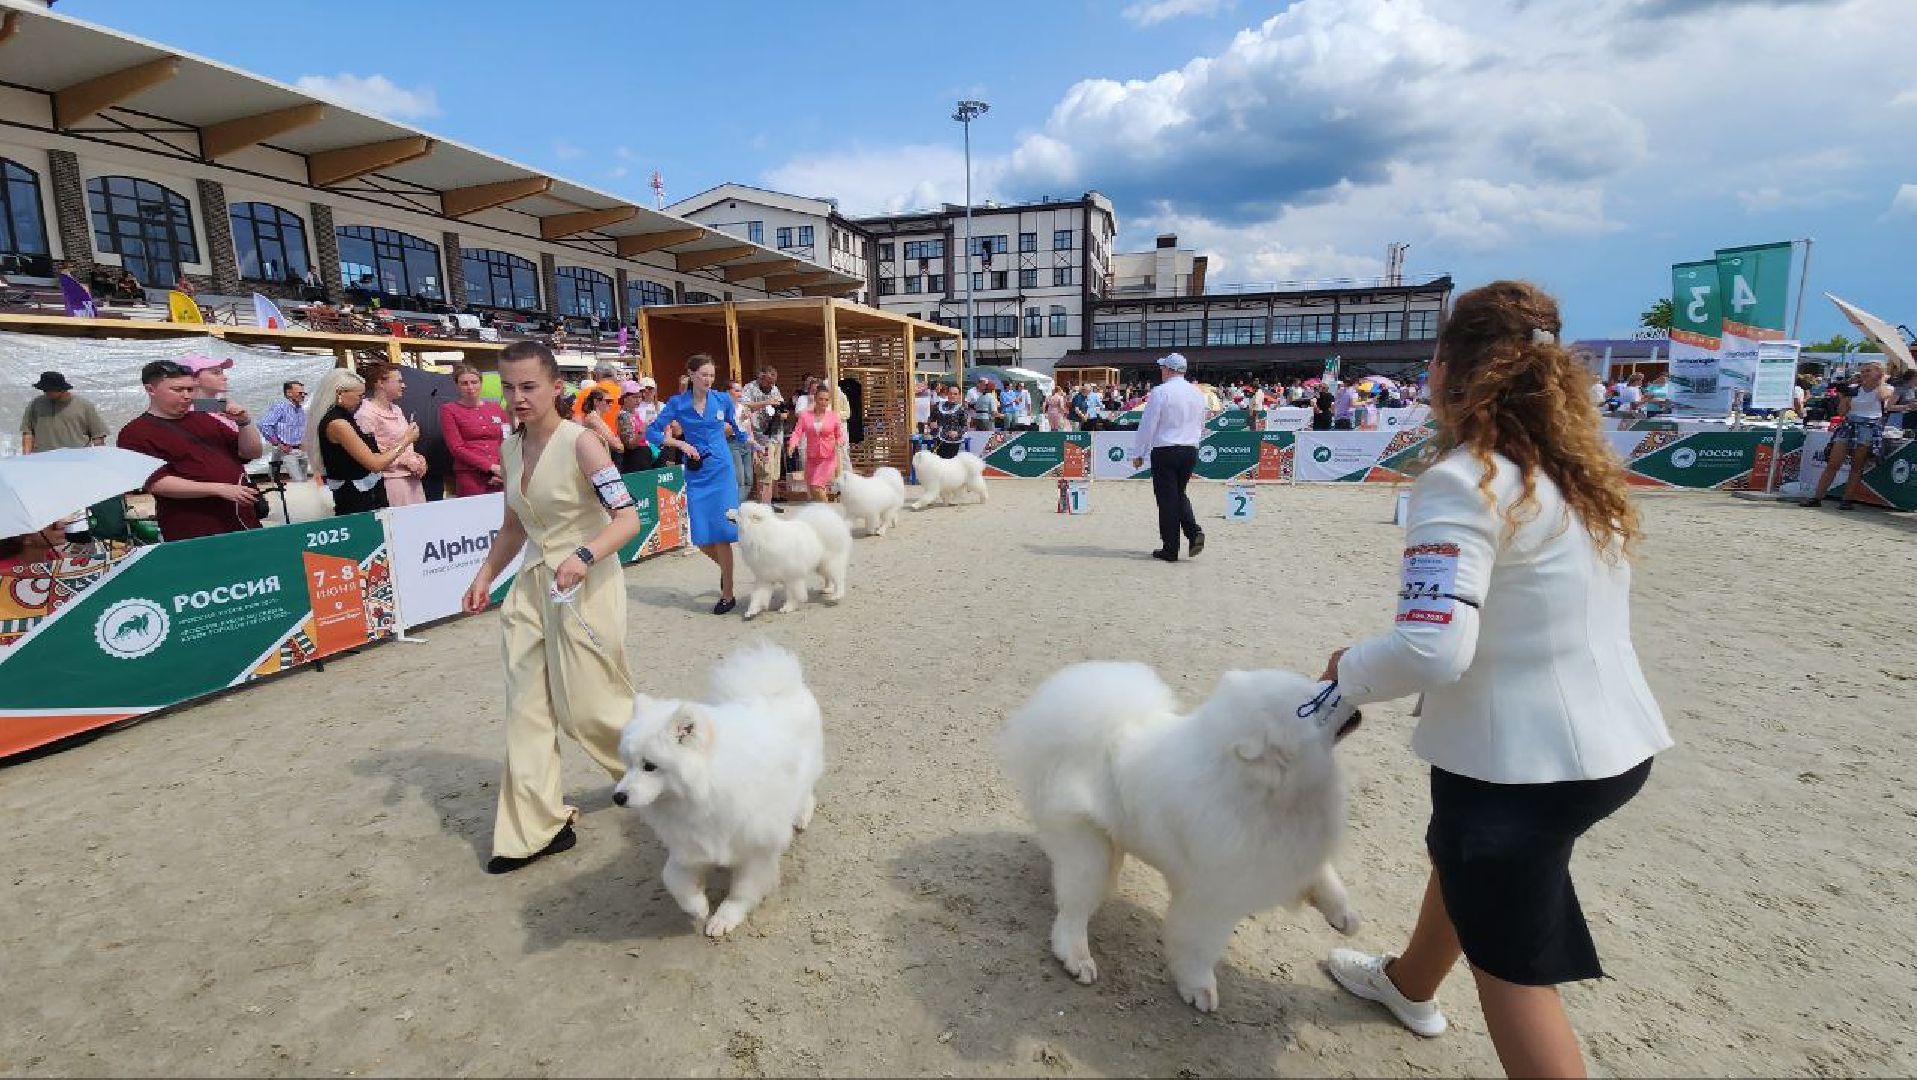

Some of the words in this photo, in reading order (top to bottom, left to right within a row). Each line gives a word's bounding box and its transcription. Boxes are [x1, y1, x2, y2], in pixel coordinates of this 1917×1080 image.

[1071, 491, 1079, 510] 1
[1234, 496, 1247, 516] 2
[306, 527, 351, 548] 2025
[173, 575, 281, 613] РОССИЯ
